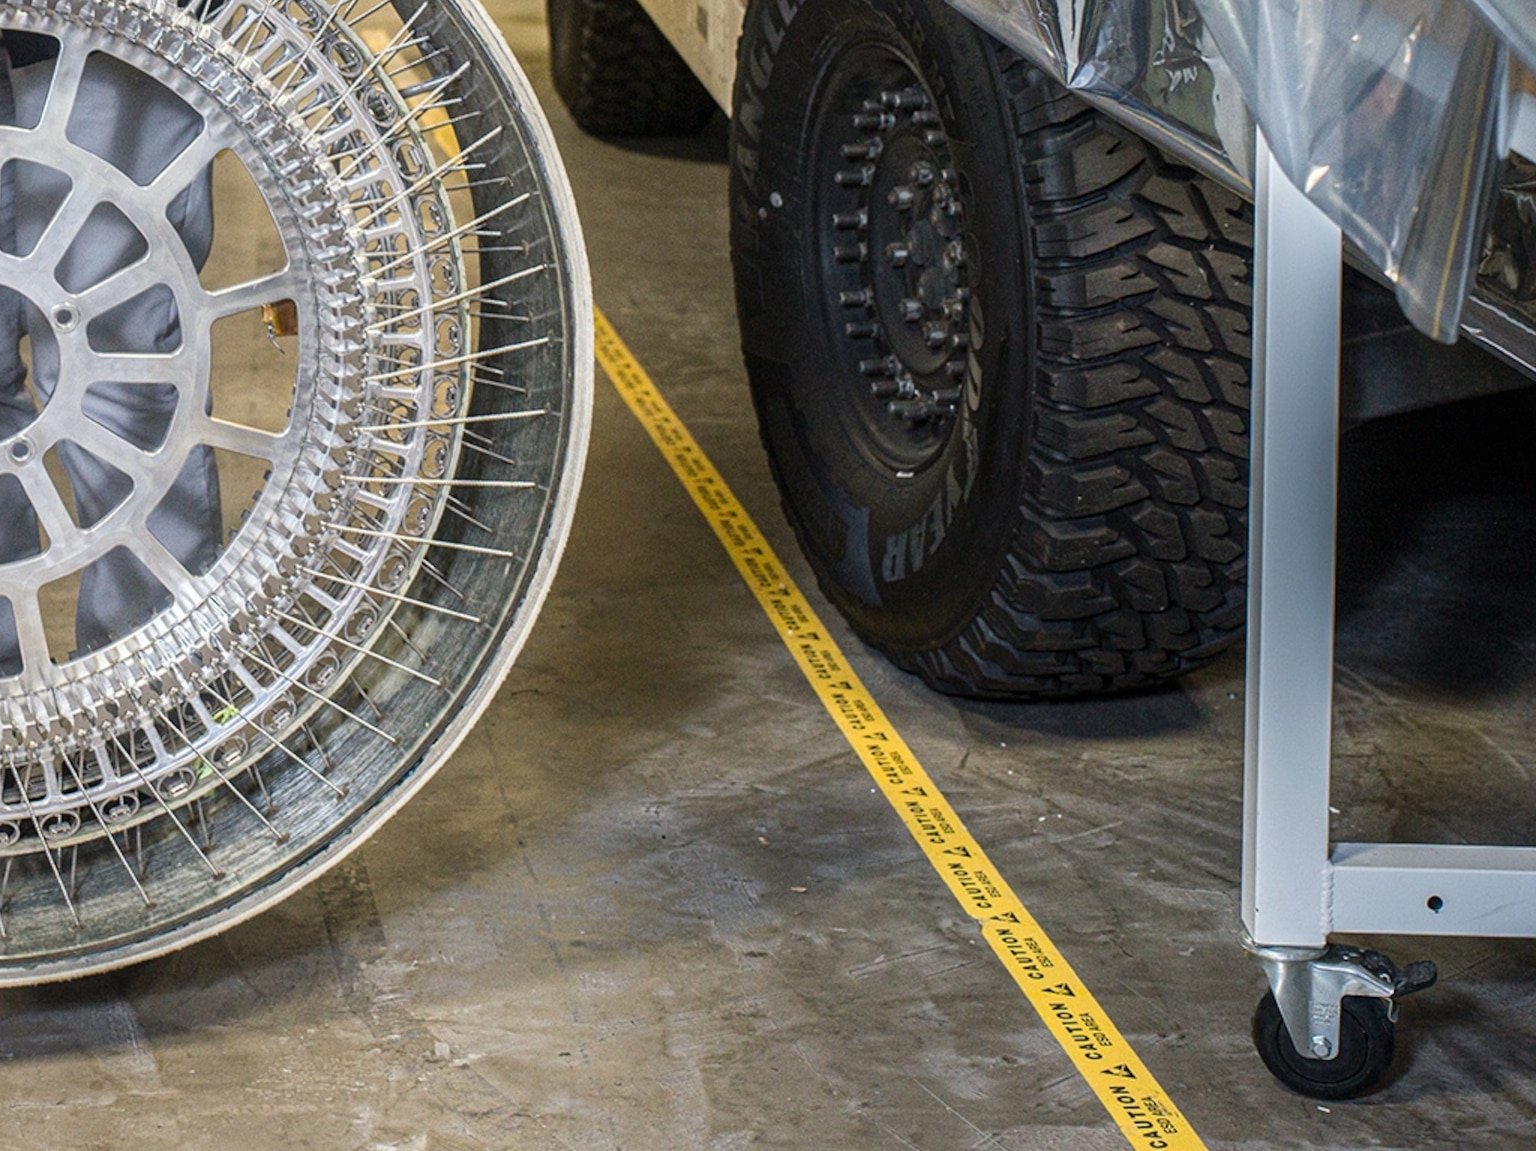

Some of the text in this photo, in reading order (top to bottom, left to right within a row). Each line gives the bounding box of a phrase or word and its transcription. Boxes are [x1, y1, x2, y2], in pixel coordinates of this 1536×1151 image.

[831, 693, 866, 730] CAUTION
[866, 744, 904, 785] CAUTION
[904, 800, 946, 844] CAUTION
[947, 862, 993, 909] CAUTION
[996, 928, 1045, 980] CAUTION
[1024, 937, 1054, 968] ESD AREA
[1049, 1002, 1103, 1061] CAUTION
[1079, 1012, 1112, 1047] ESD AREA
[1109, 1085, 1168, 1150] CAUTION
[1141, 1095, 1179, 1135] ESD AREA
